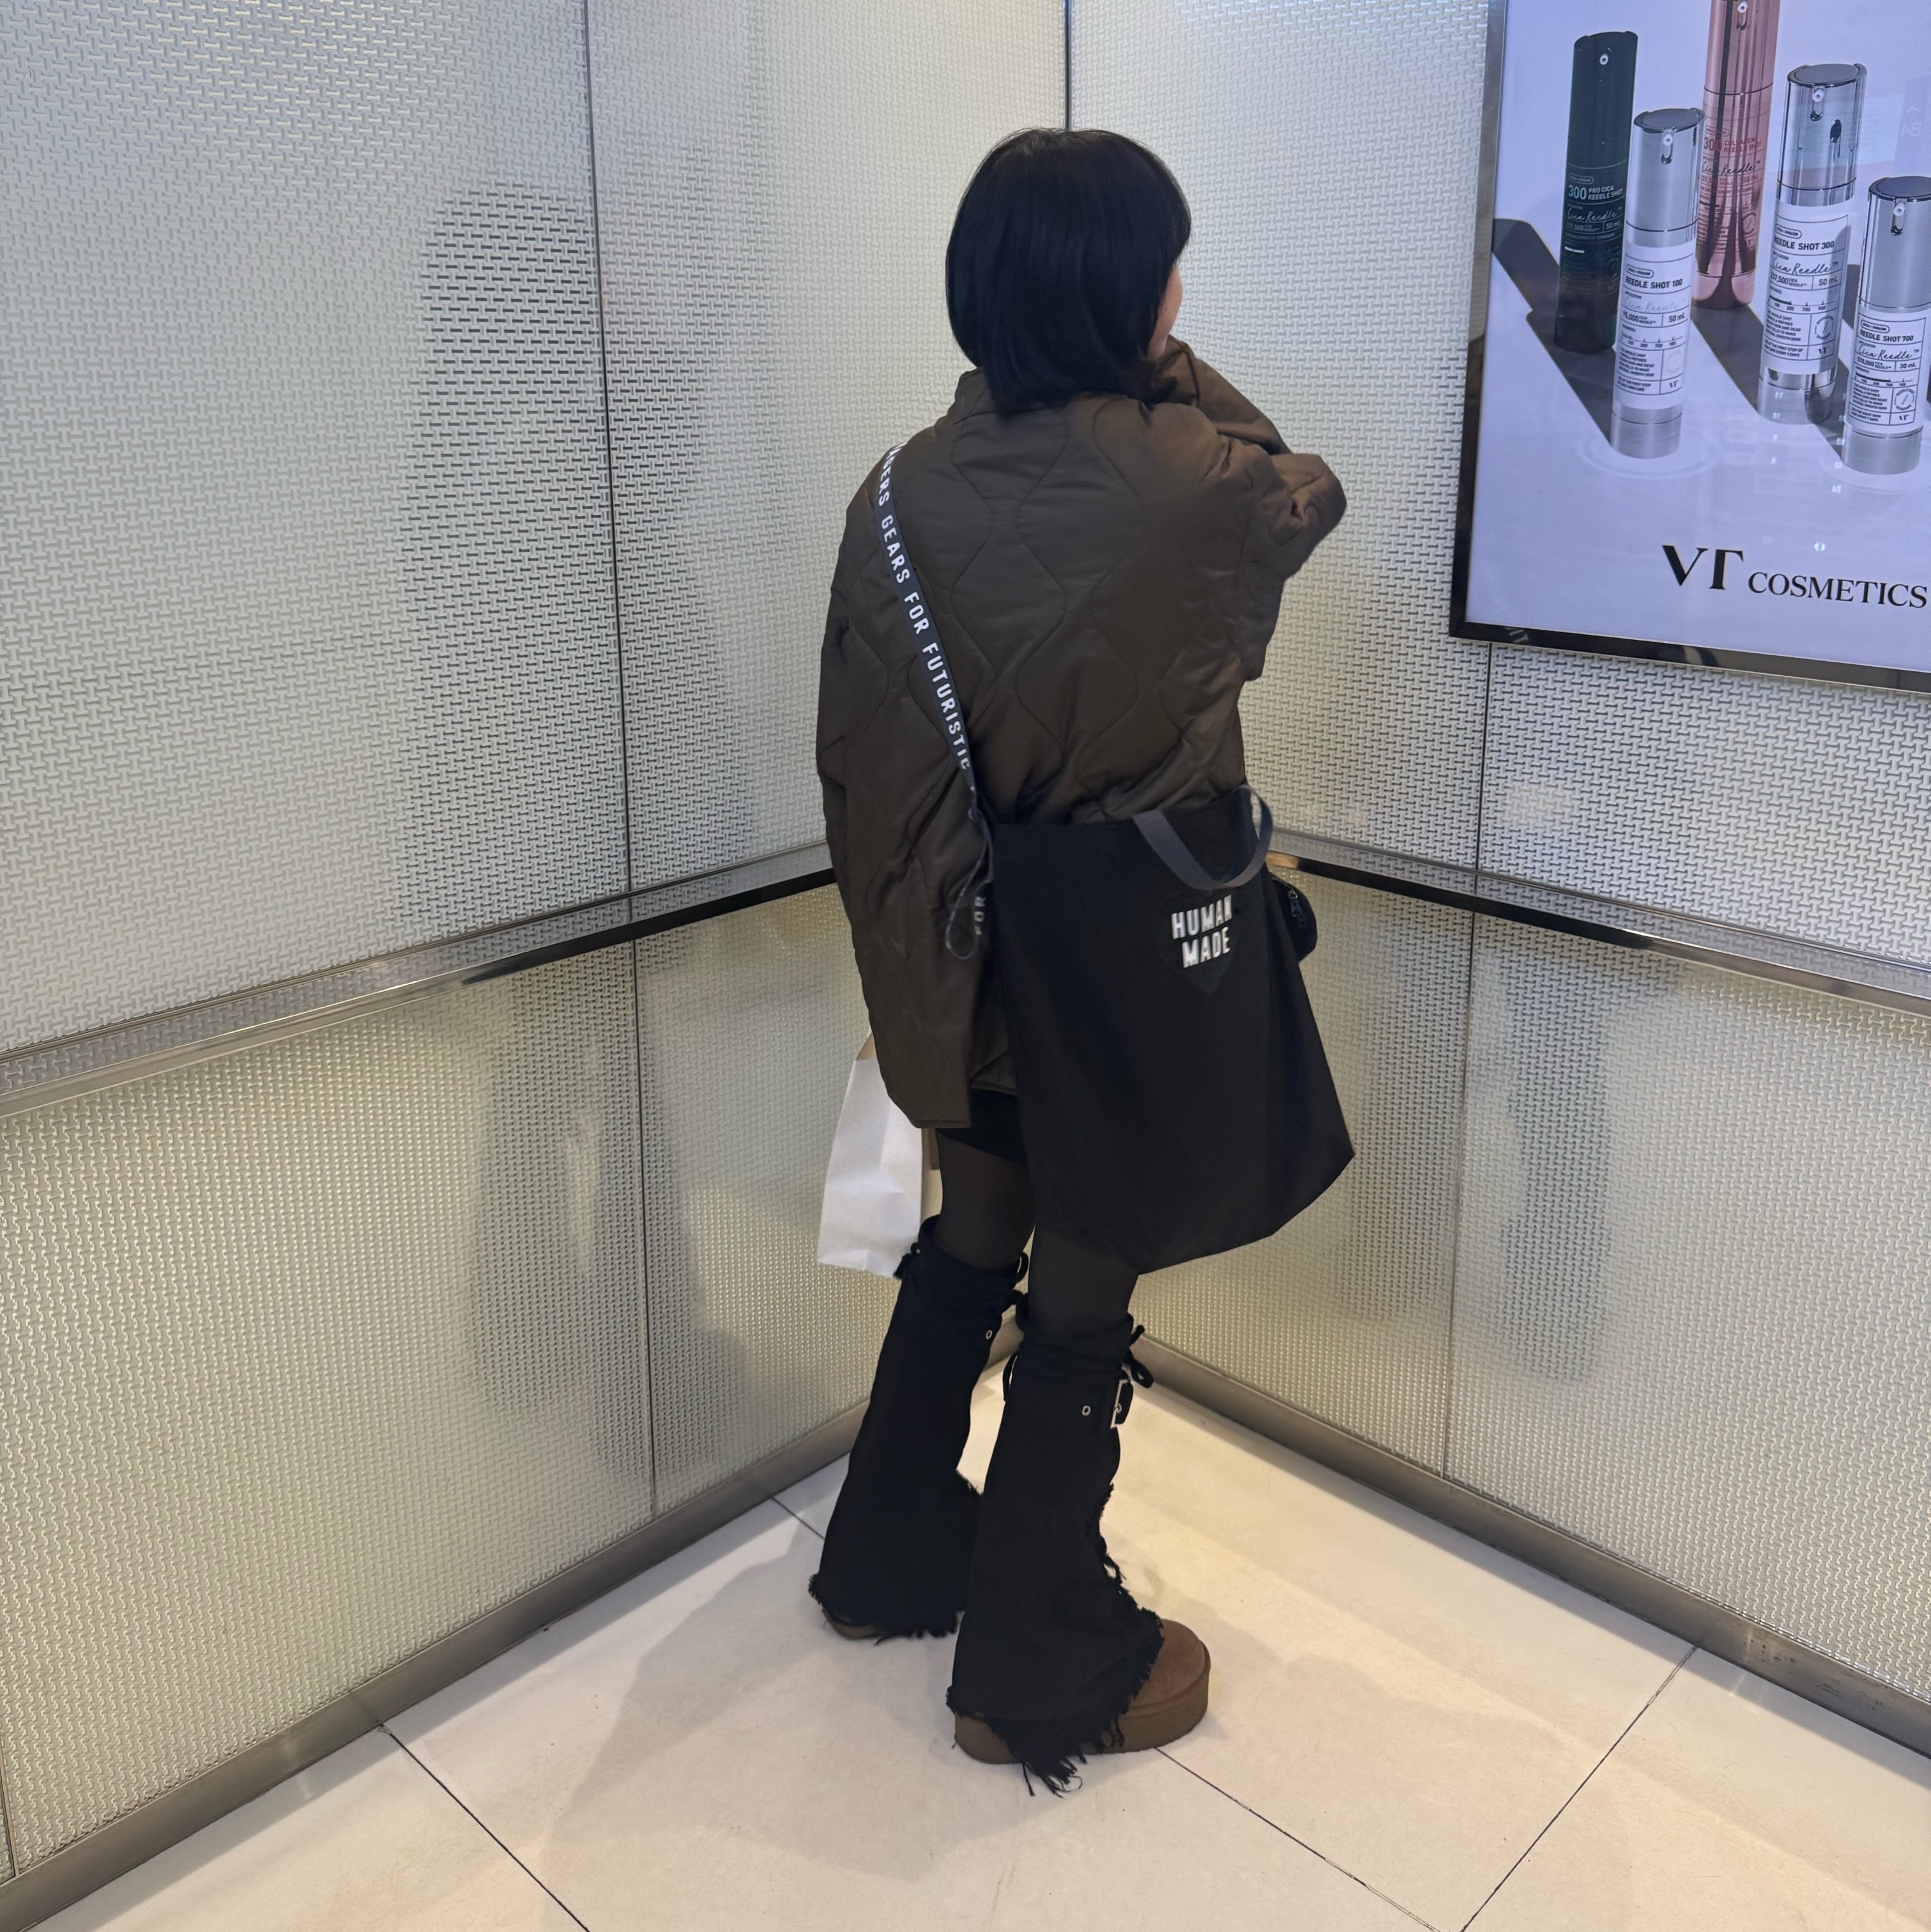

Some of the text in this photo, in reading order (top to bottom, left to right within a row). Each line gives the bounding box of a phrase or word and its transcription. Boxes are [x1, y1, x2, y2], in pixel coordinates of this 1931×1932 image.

[1568, 185, 1587, 200] 300
[1588, 192, 1610, 201] REEDLE
[1774, 235, 1796, 249] REEDLE
[1821, 241, 1835, 249] 300
[1626, 275, 1683, 289] REEDLE SHOT 100
[1829, 276, 1838, 284] mL
[1860, 329, 1881, 340] REEDLE
[1661, 545, 1928, 609] VT COSMETICS
[882, 515, 910, 583] GEARS
[904, 592, 929, 635] FOR
[922, 643, 970, 770] FUTURISTIC
[973, 896, 986, 936] FOR
[1182, 926, 1231, 968] MADE
